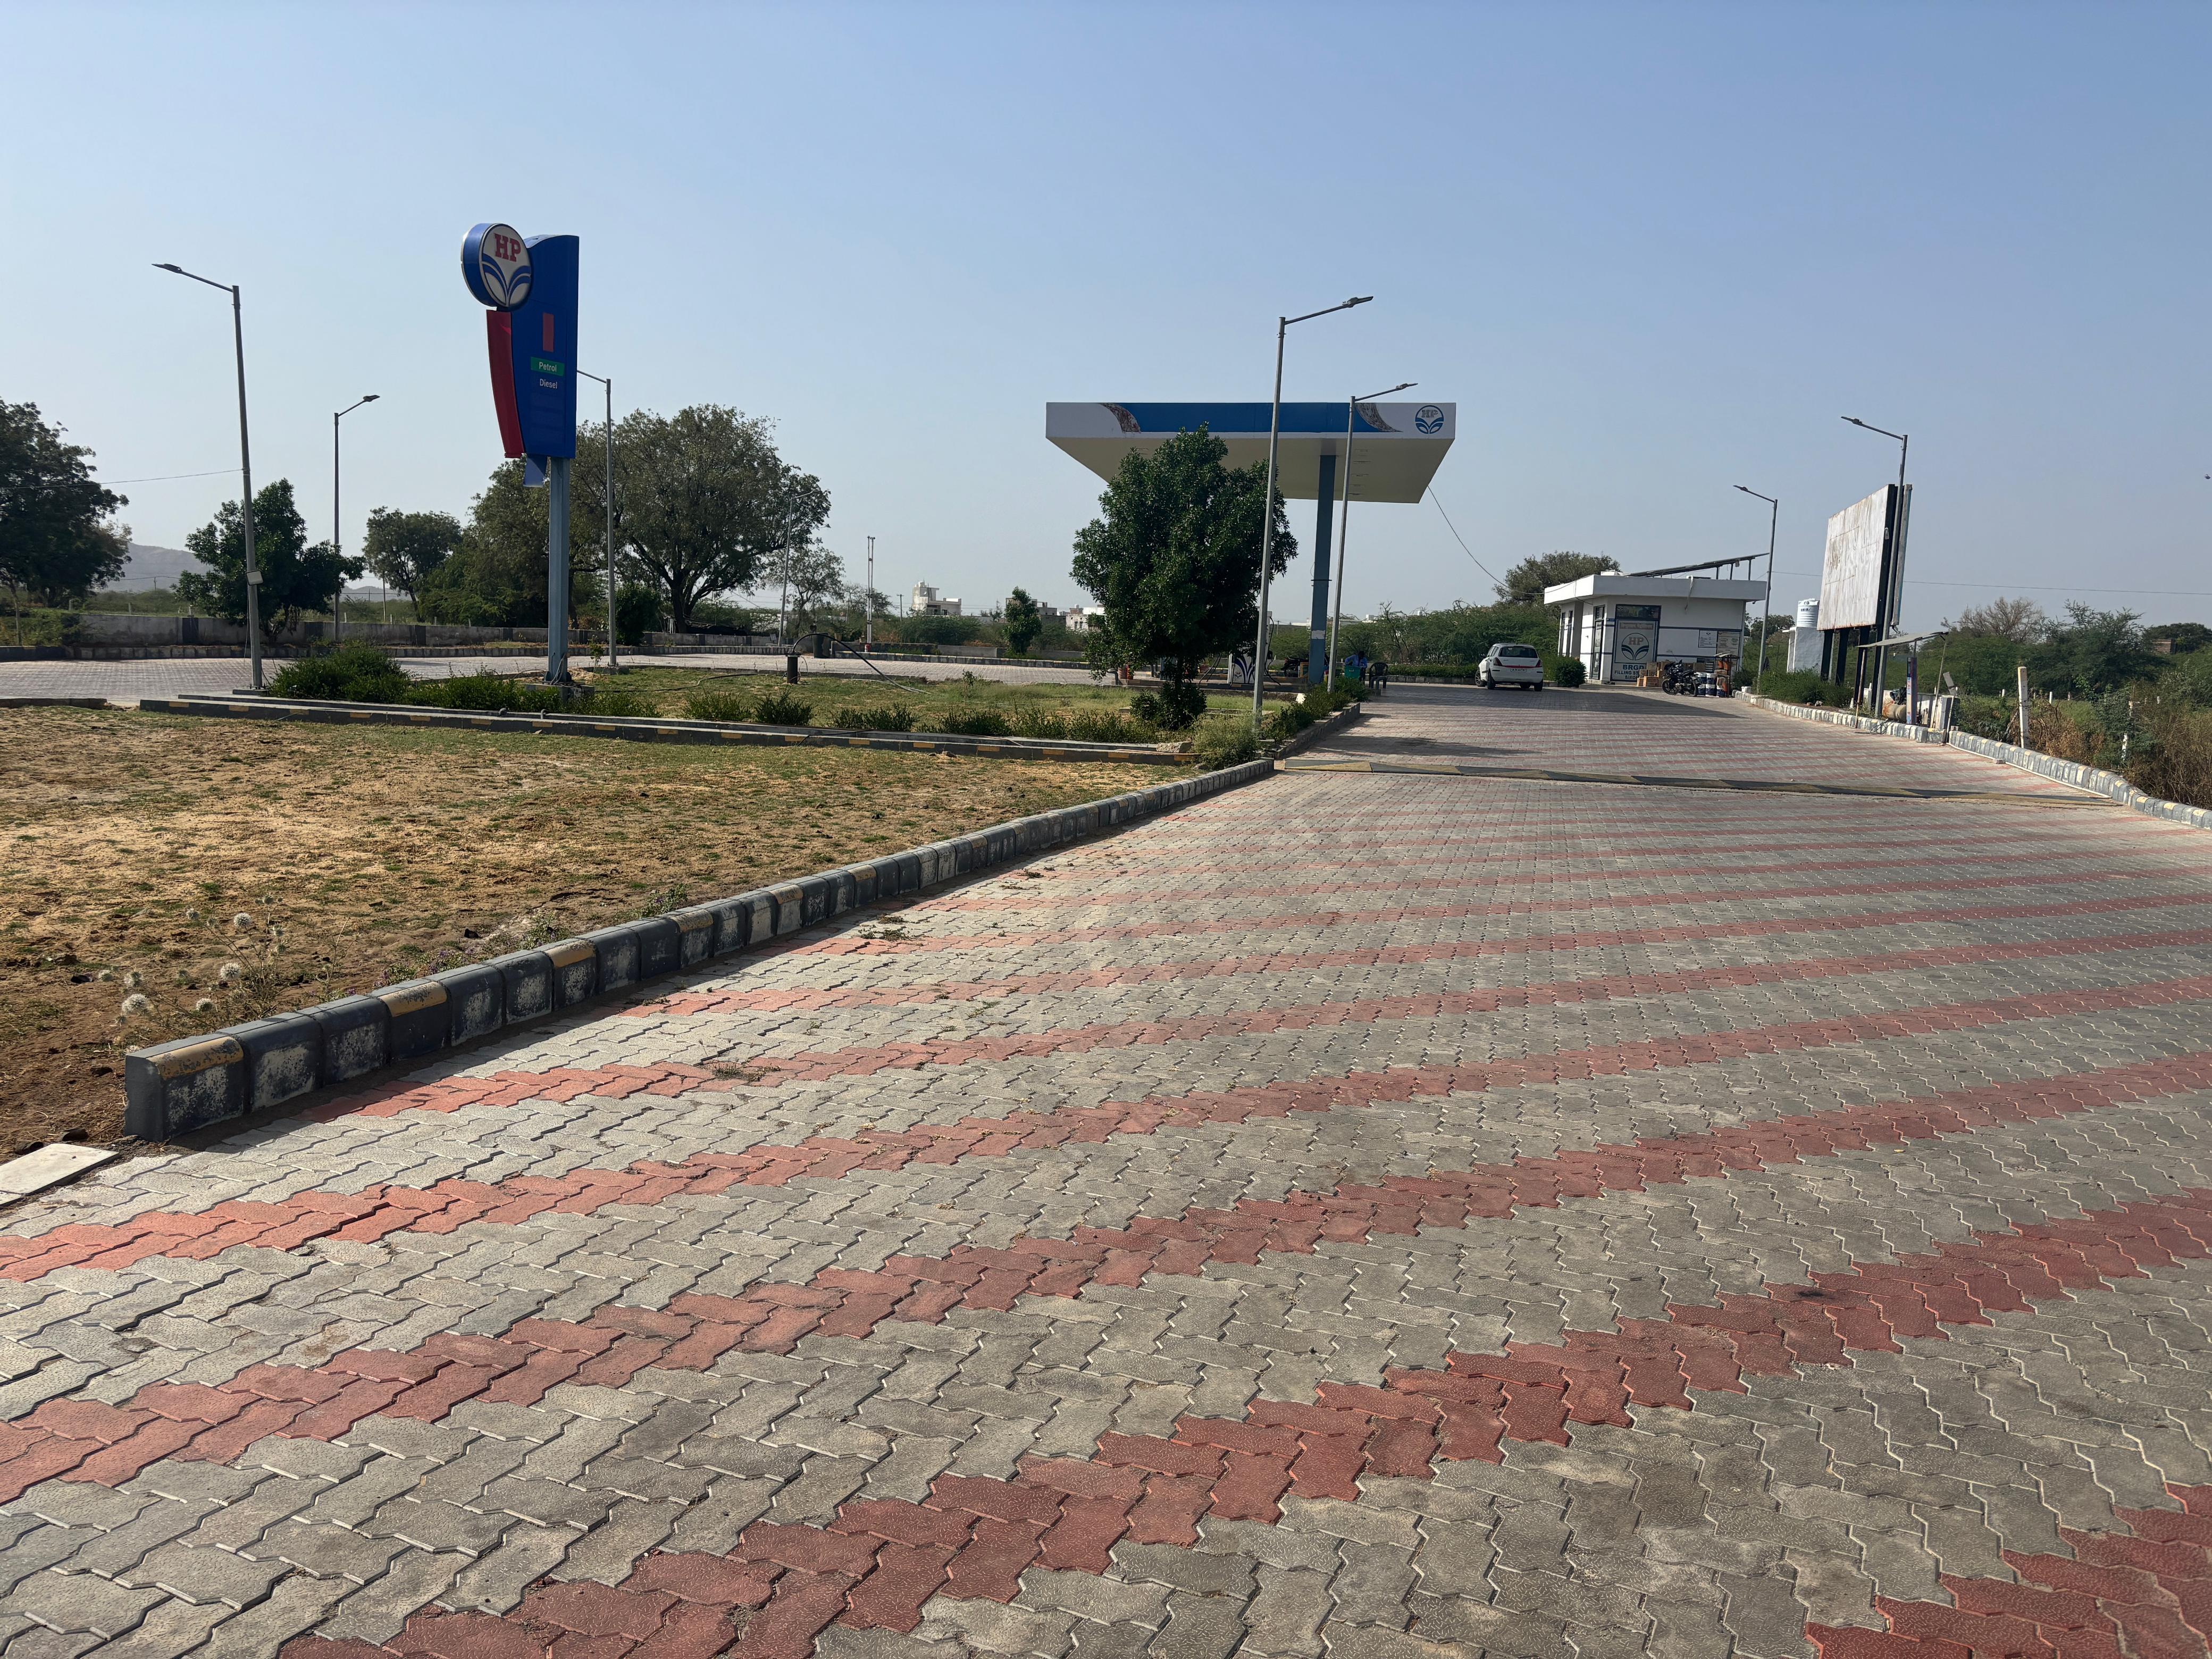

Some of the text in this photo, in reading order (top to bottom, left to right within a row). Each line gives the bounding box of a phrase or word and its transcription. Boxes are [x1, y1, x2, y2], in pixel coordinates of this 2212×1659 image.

[493, 232, 521, 262] HP
[539, 362, 557, 372] Petrol
[540, 379, 558, 389] Diesel
